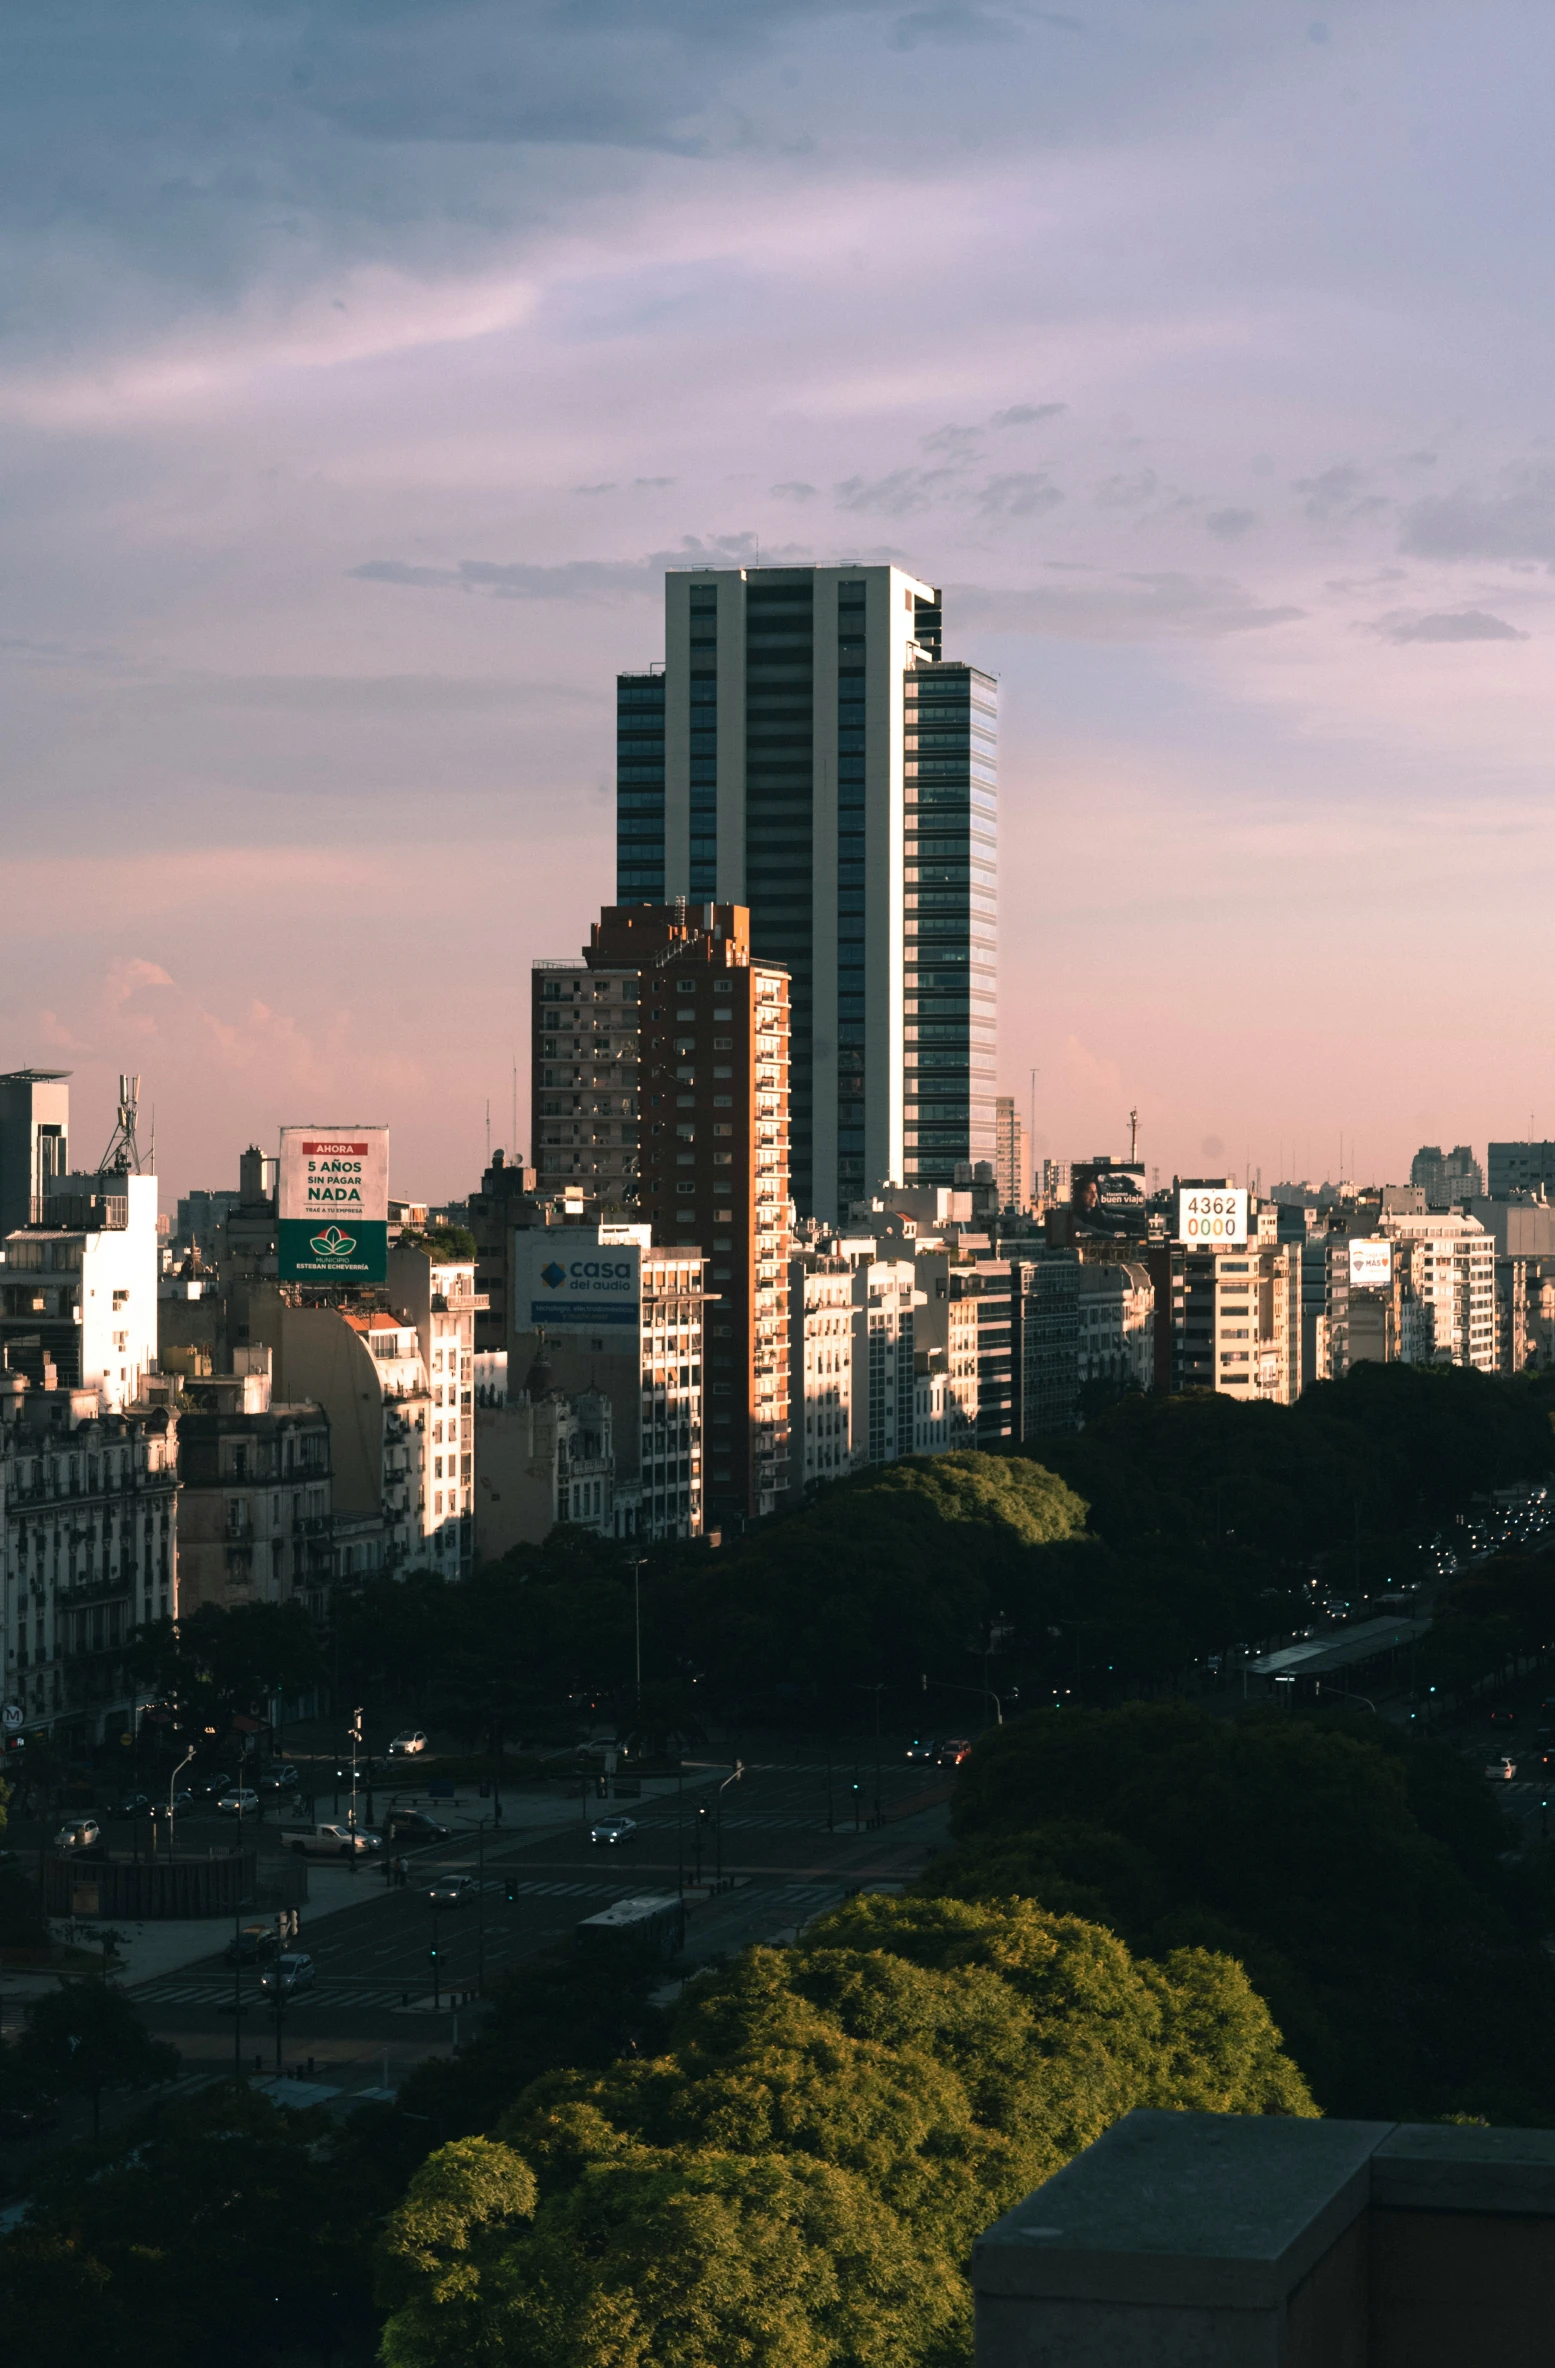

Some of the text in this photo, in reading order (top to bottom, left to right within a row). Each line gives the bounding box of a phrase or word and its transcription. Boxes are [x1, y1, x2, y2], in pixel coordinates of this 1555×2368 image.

[316, 1144, 354, 1153] AHORA
[308, 1159, 362, 1172] 5 AÑOS
[308, 1176, 361, 1185] SIN PAGAR
[308, 1187, 361, 1201] NADA
[1101, 1194, 1144, 1204] buen viaje
[1188, 1197, 1236, 1214] 4362
[1188, 1218, 1236, 1236] 0000
[570, 1262, 630, 1278] casa
[570, 1280, 631, 1291] del audio
[6, 1708, 20, 1720] M
